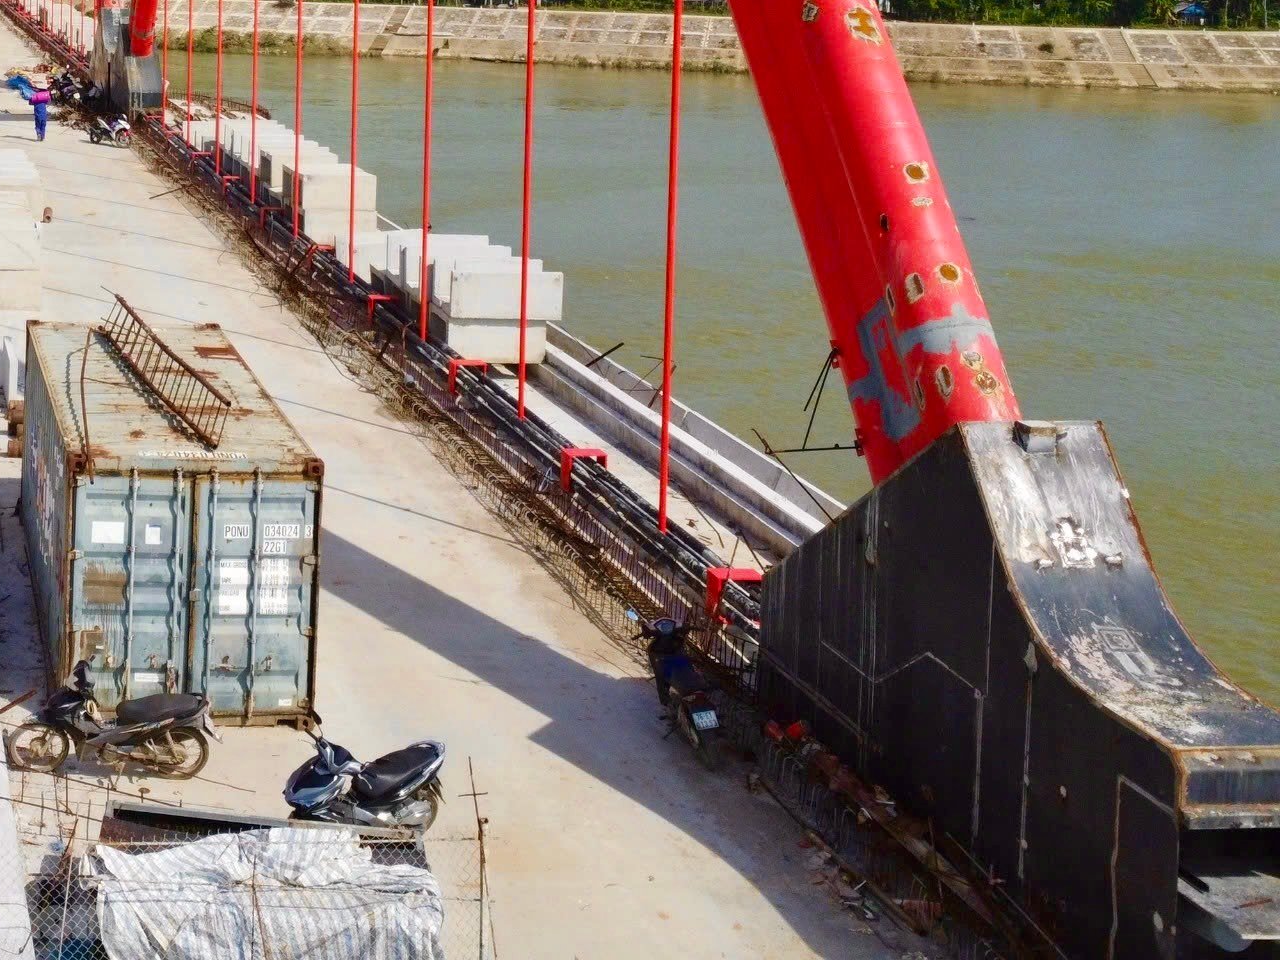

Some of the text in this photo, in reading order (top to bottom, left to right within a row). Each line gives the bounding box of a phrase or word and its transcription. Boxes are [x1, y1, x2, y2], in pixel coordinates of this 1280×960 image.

[224, 525, 313, 537] PONU 034024 3
[263, 541, 286, 553] 22G1
